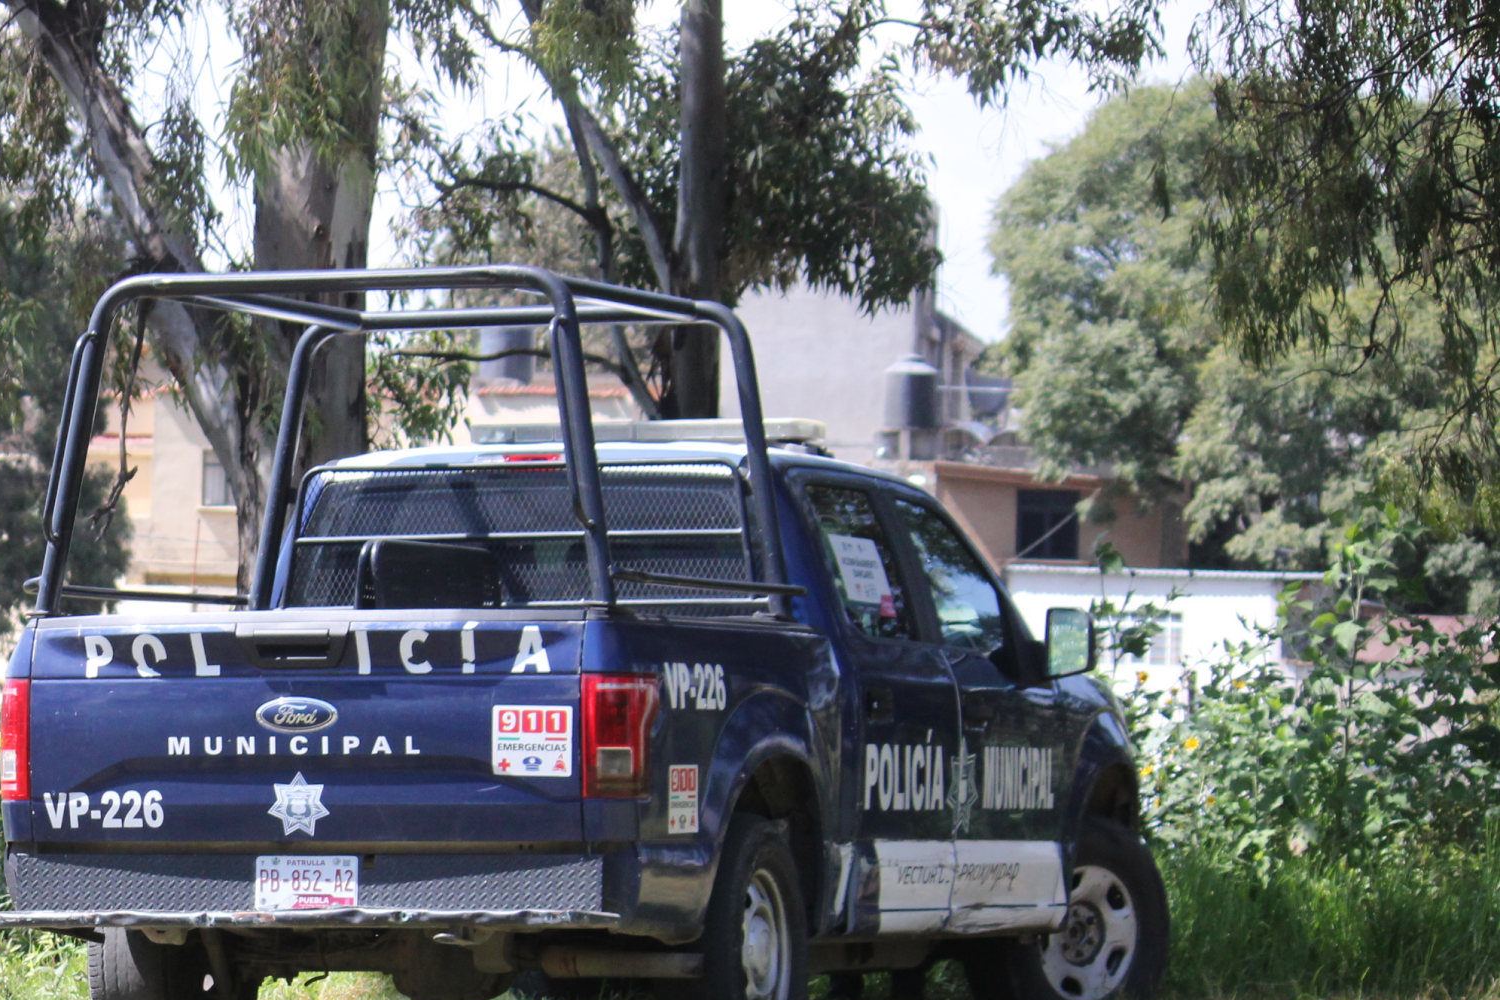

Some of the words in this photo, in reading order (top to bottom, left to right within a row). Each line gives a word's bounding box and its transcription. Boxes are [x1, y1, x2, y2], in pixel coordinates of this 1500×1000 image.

[84, 621, 551, 678] POLICÍA
[664, 662, 726, 711] VP-226
[273, 704, 318, 725] Ford
[501, 711, 562, 731] 911
[167, 735, 421, 756] MUNICIPAL
[497, 743, 567, 752] EMERGENCIAS
[672, 769, 695, 791] 911
[864, 728, 945, 811] POLICÍA
[982, 745, 1055, 810] MUNICIPAL
[43, 789, 165, 829] VP-226
[260, 869, 353, 892] PB-852-A2
[299, 896, 330, 904] PUEBLA
